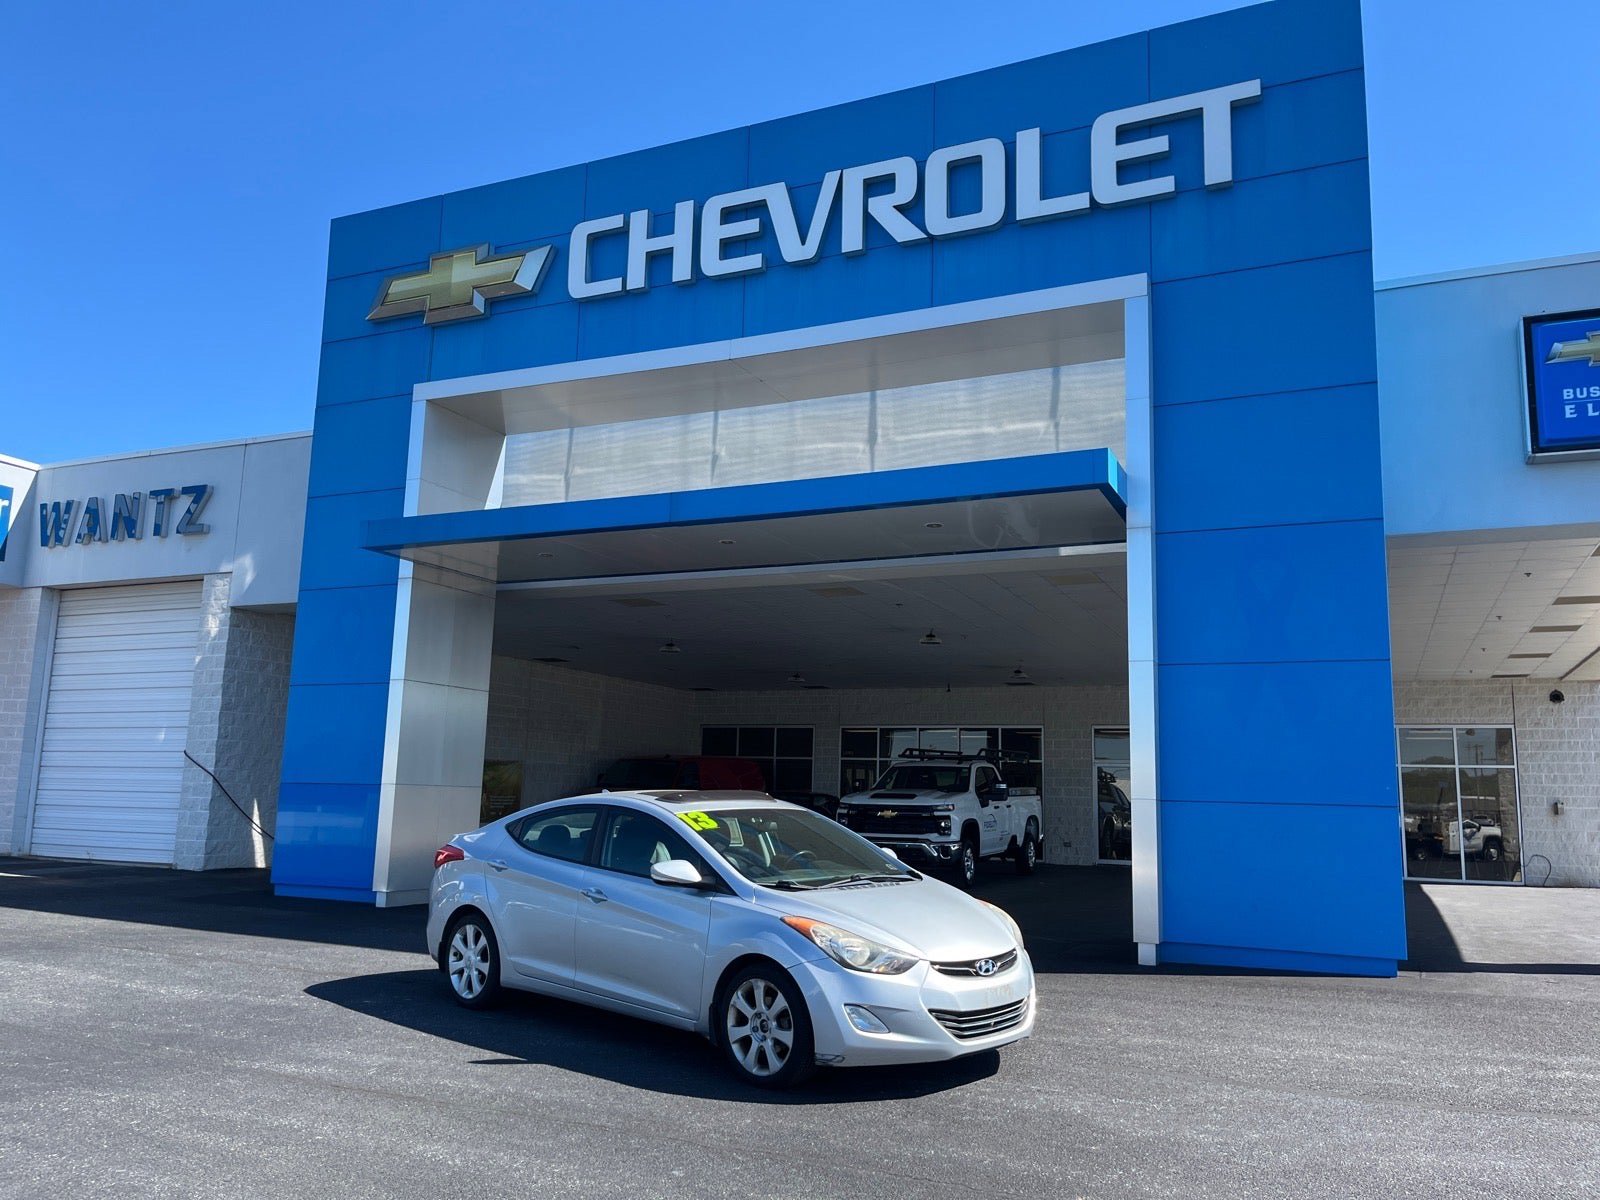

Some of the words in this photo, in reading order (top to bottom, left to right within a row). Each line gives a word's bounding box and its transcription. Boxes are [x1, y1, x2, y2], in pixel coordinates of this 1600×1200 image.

[567, 78, 1262, 301] CHEVROLET
[39, 484, 214, 548] WANTZ
[676, 810, 720, 832] 13
